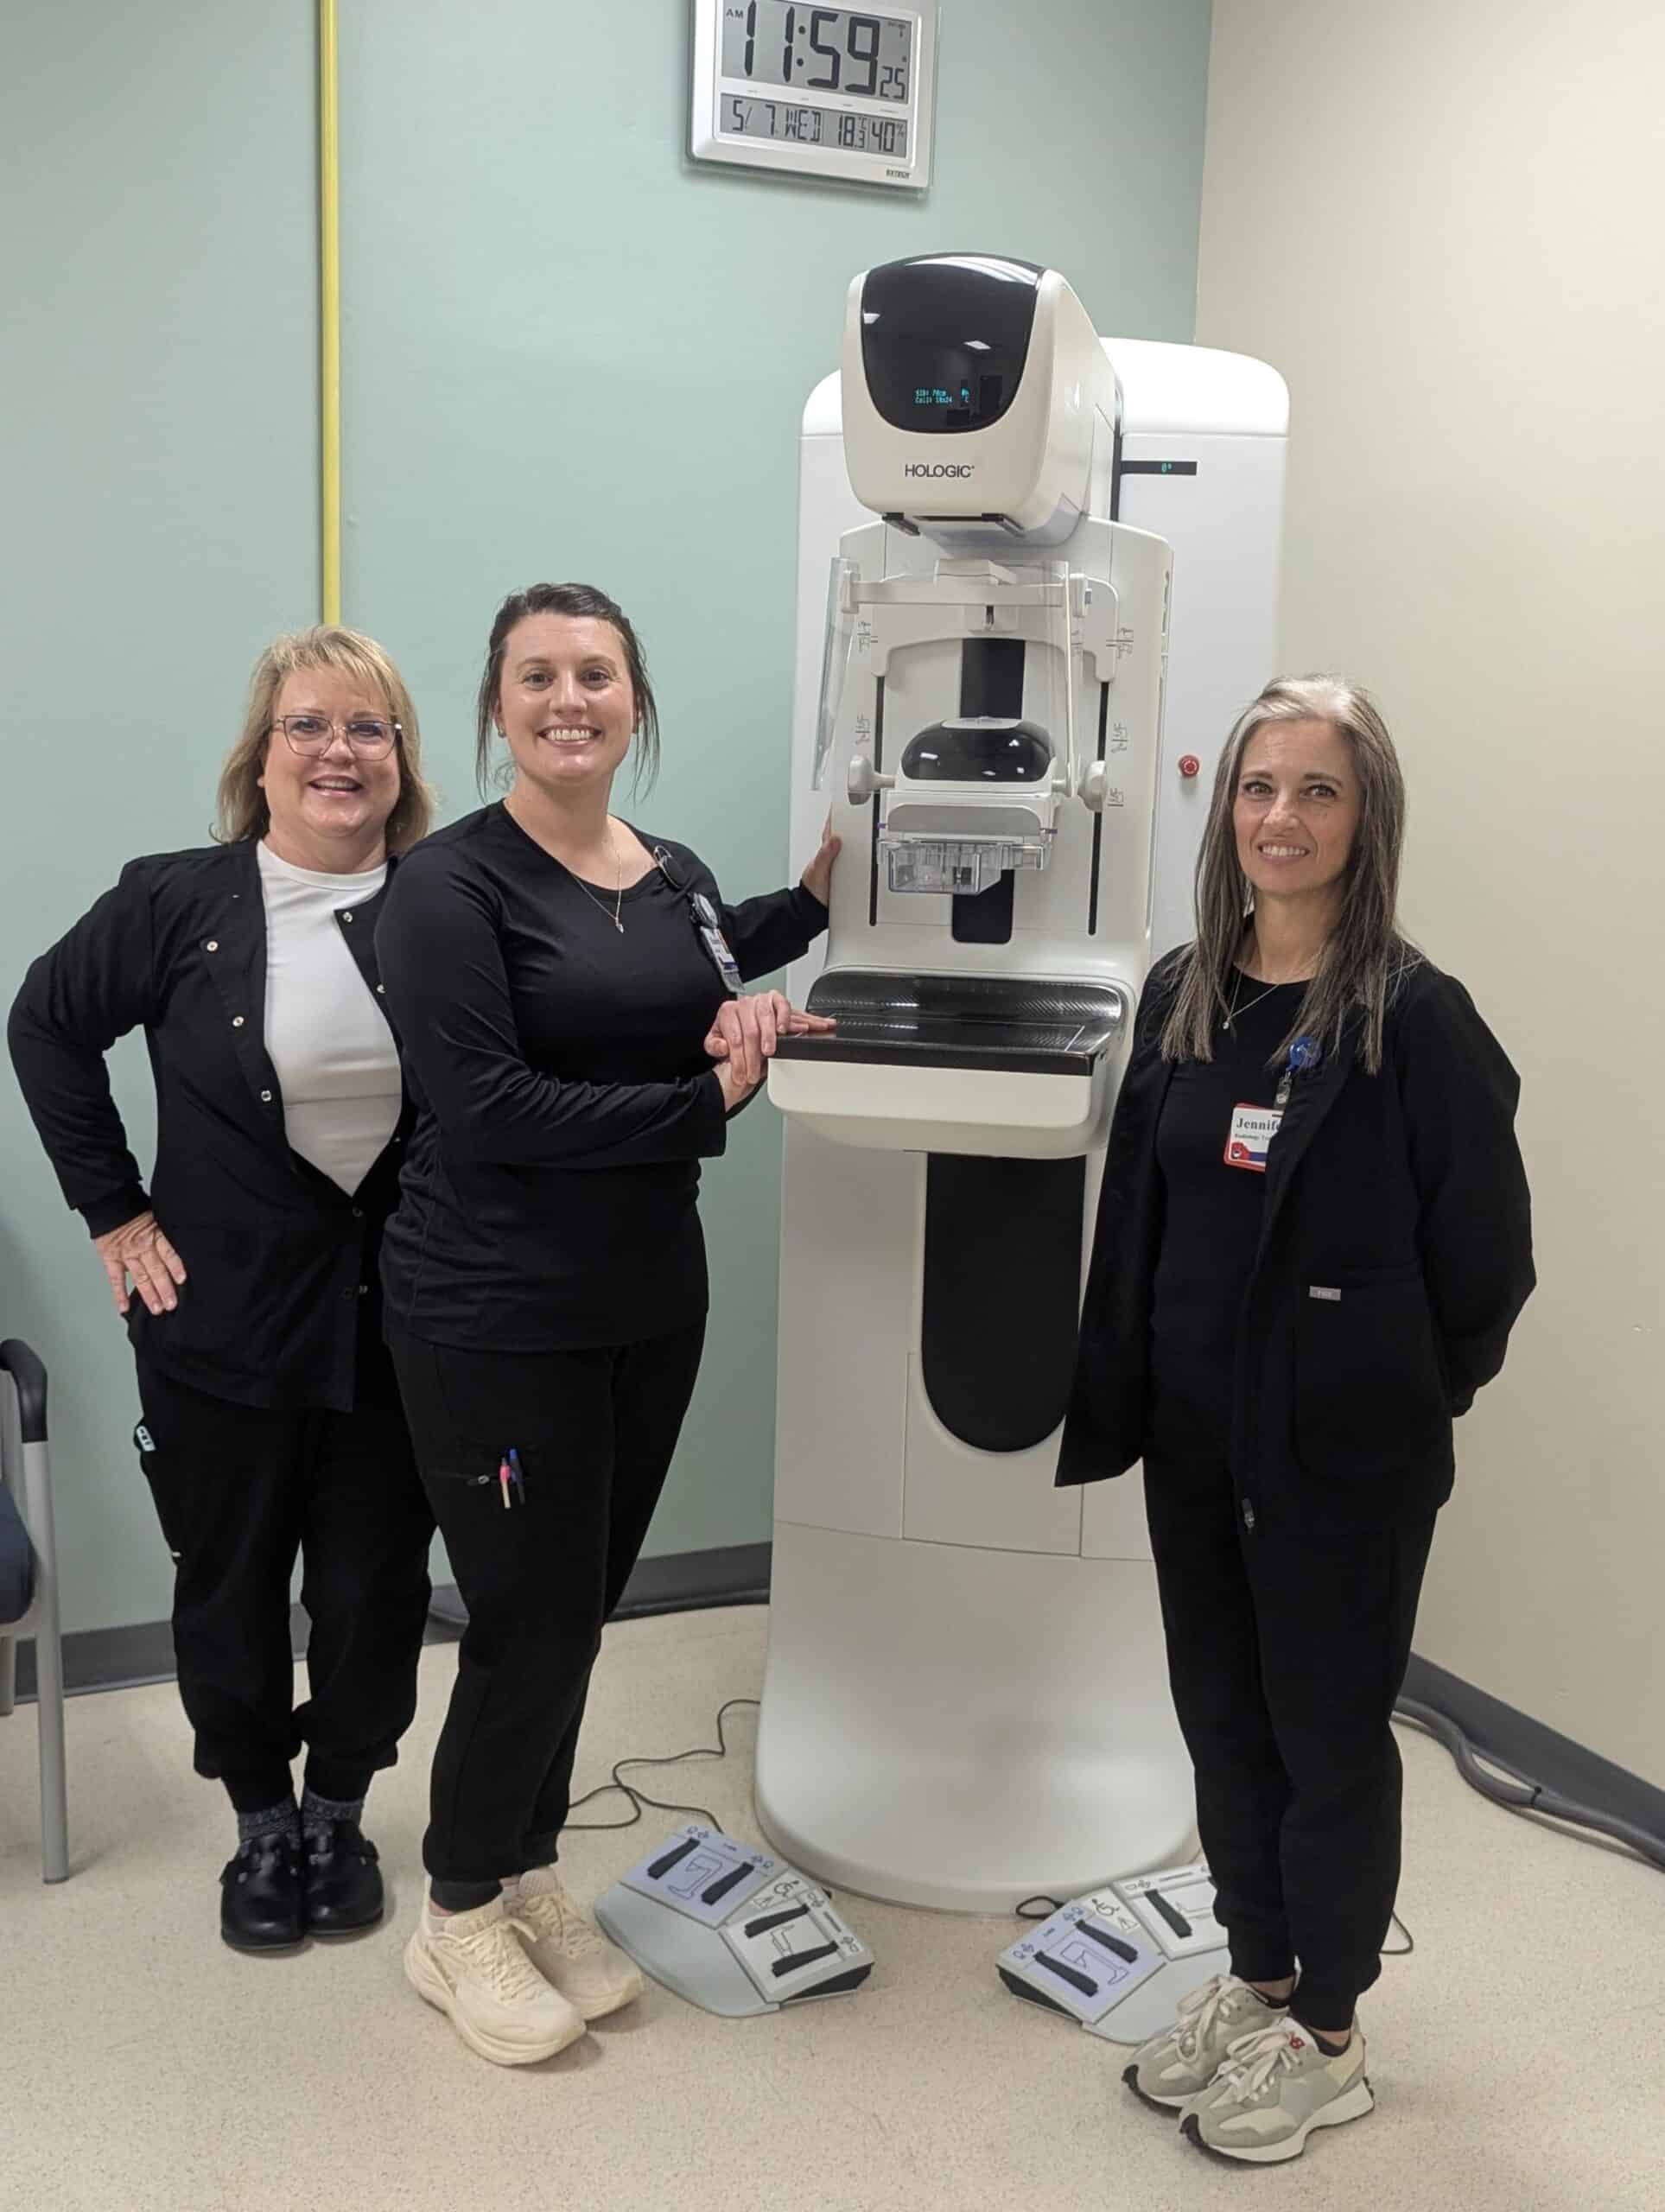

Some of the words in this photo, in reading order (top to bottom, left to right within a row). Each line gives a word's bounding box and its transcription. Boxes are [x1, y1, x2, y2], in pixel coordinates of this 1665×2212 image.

[726, 8, 744, 18] AM
[744, 0, 880, 95] 11:59
[880, 65, 906, 99] 25
[904, 463, 972, 478] HOLOGIC
